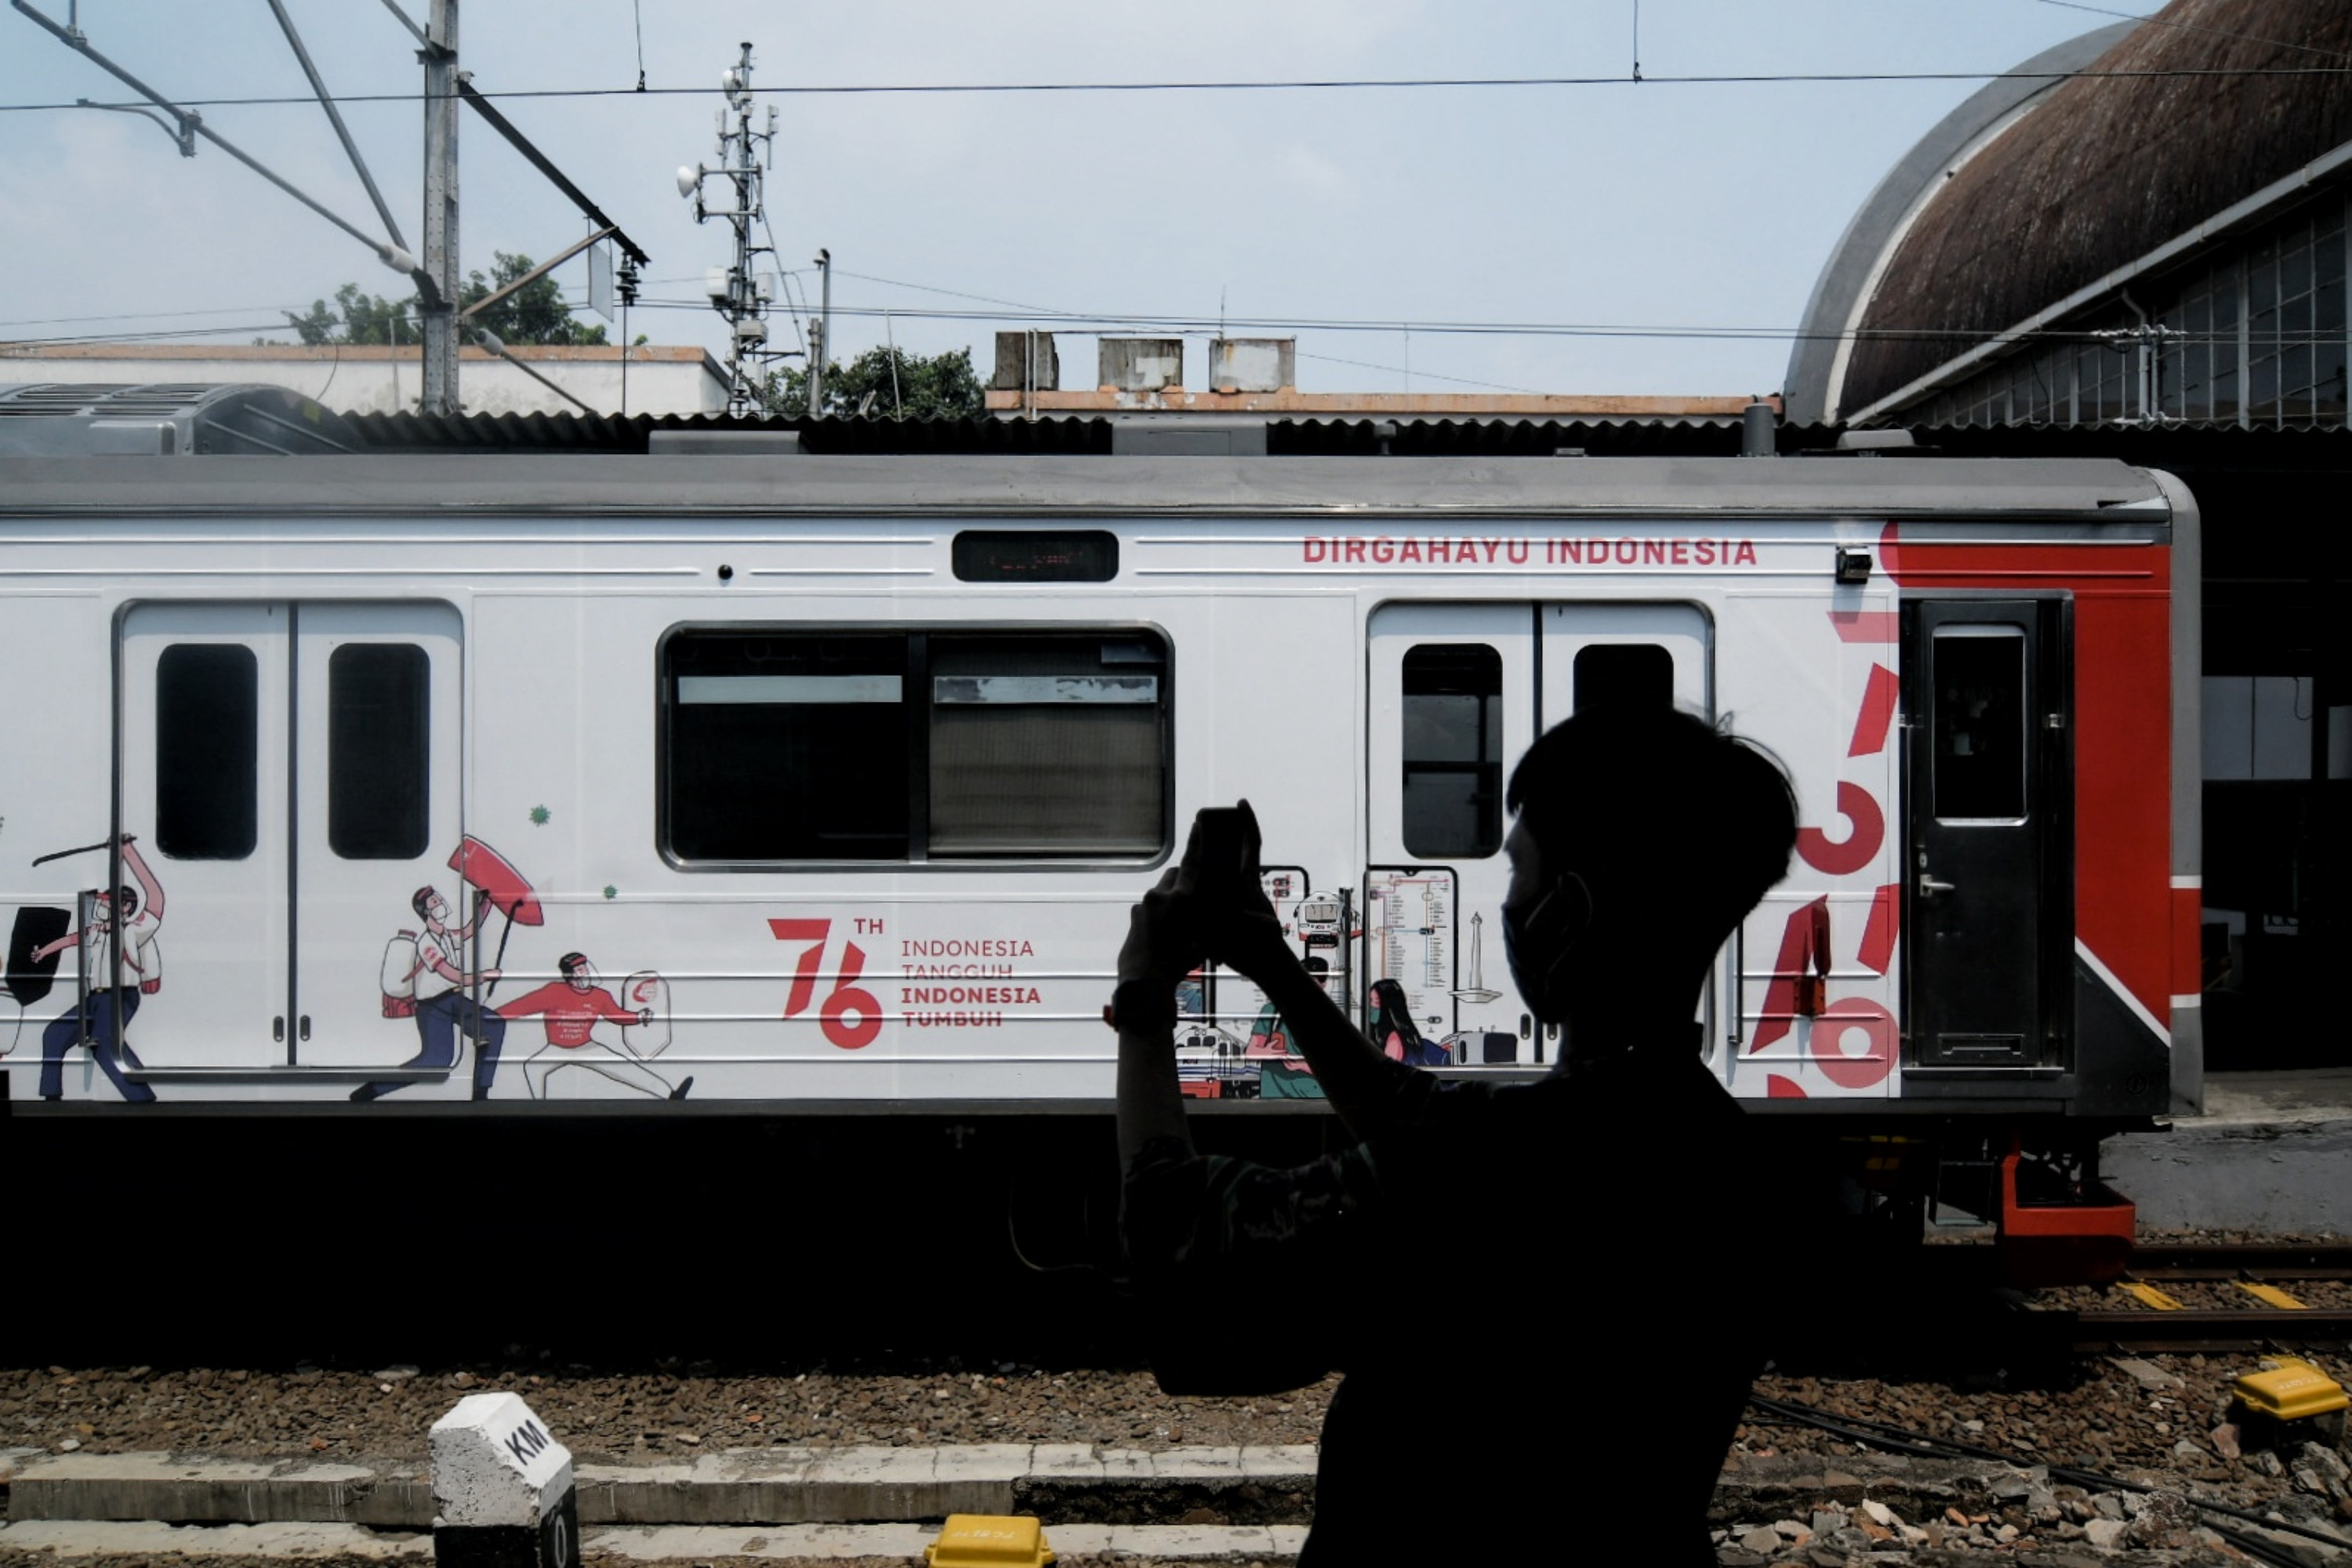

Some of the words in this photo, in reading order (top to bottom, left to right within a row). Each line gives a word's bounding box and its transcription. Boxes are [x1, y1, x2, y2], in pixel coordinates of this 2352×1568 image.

[1303, 536, 1530, 564] DIRGAHAYU
[1546, 537, 1757, 565] INDONESIA
[854, 918, 884, 935] TH
[902, 940, 1034, 956] INDONESIA
[902, 964, 1013, 980] TANGGUH
[902, 987, 1041, 1004] INDONESIA
[902, 1011, 1002, 1027] TUMBUH
[504, 1418, 550, 1466] KM
